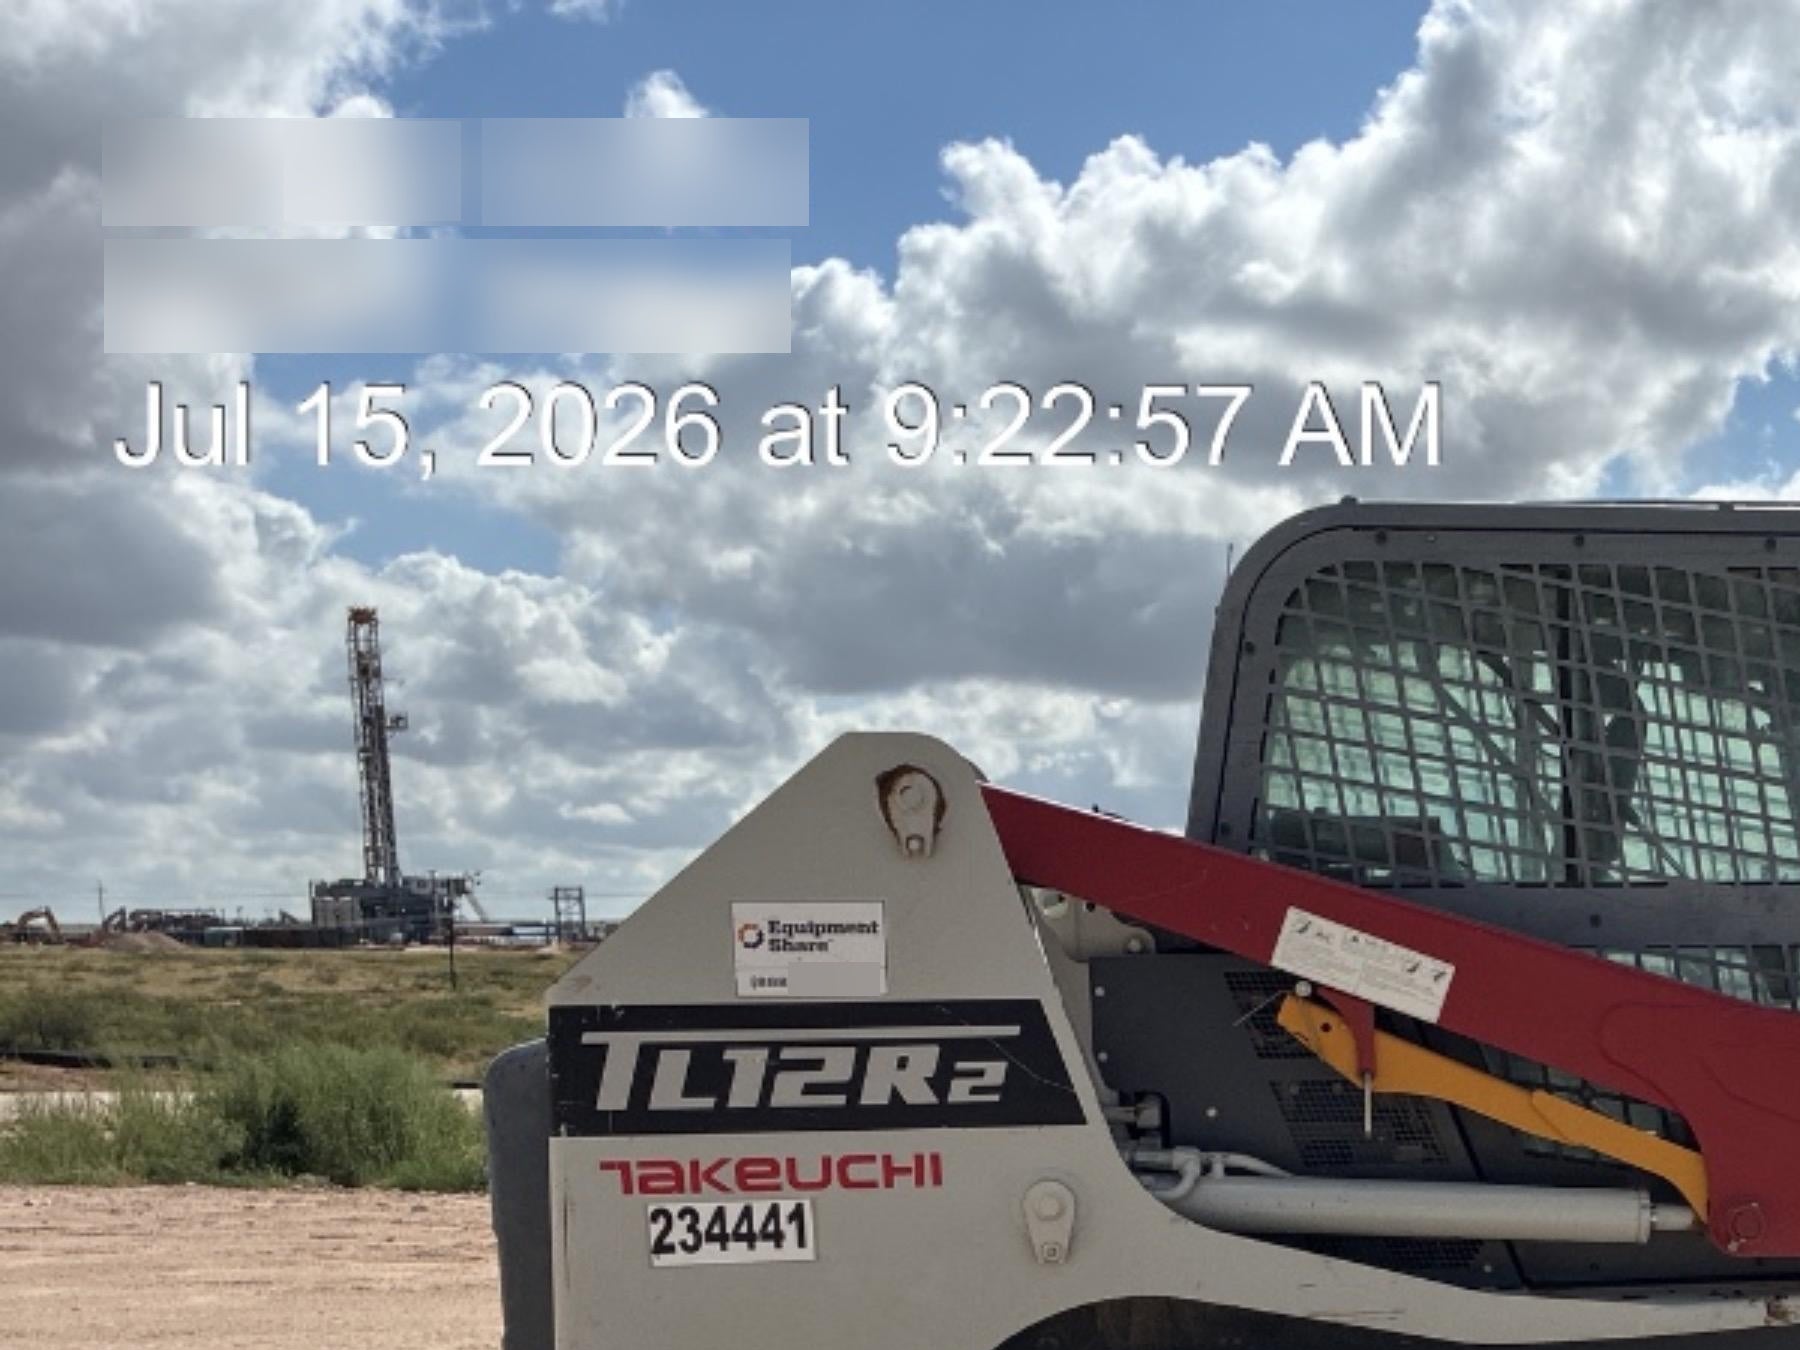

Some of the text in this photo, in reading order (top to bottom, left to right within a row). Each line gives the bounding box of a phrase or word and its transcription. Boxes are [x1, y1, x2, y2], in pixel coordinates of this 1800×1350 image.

[768, 919, 879, 938] Equipment
[768, 938, 829, 952] Share
[650, 1203, 807, 1256] 234441
